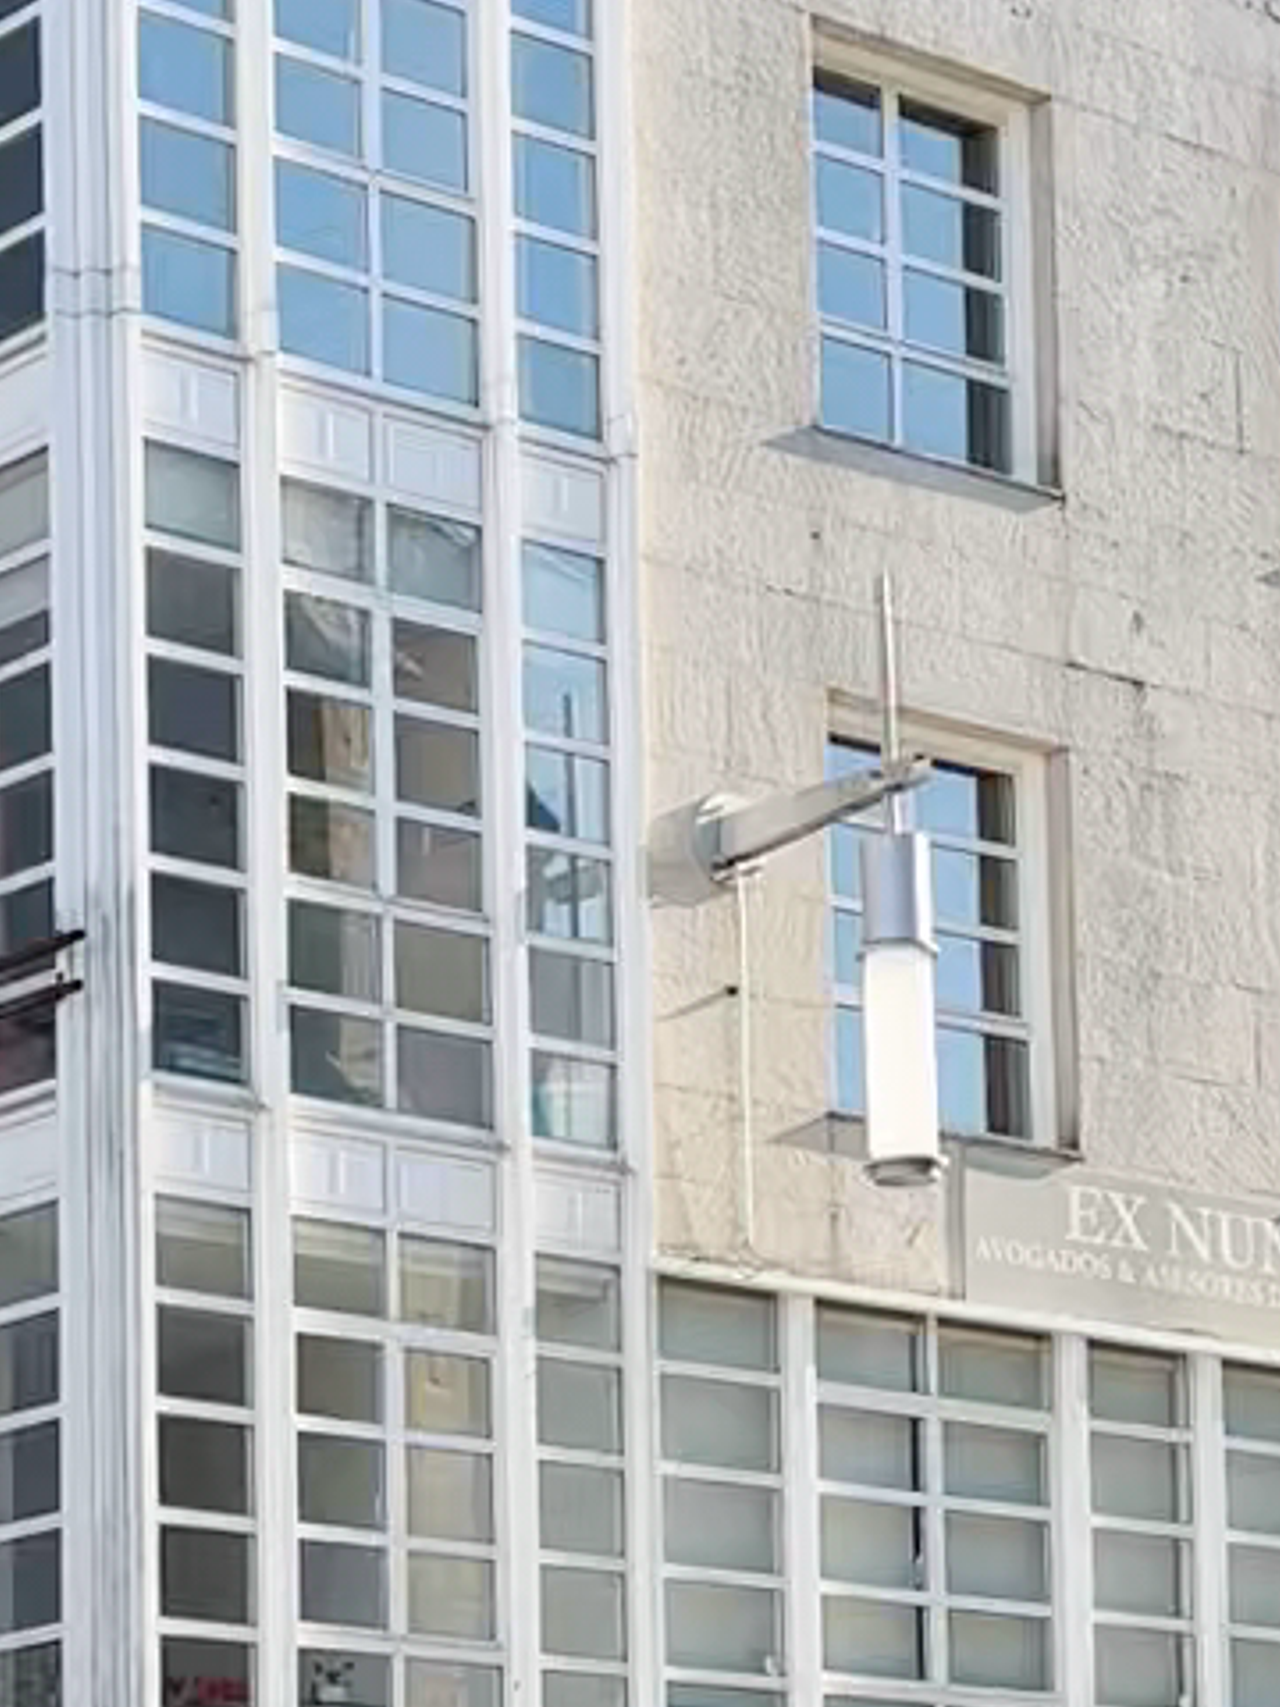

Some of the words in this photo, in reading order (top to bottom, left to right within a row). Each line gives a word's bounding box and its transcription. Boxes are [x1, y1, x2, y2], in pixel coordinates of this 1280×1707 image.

[1065, 1184, 1149, 1253] EX
[974, 1235, 1112, 1282] AVOGADOS
[1119, 1259, 1137, 1284] &
